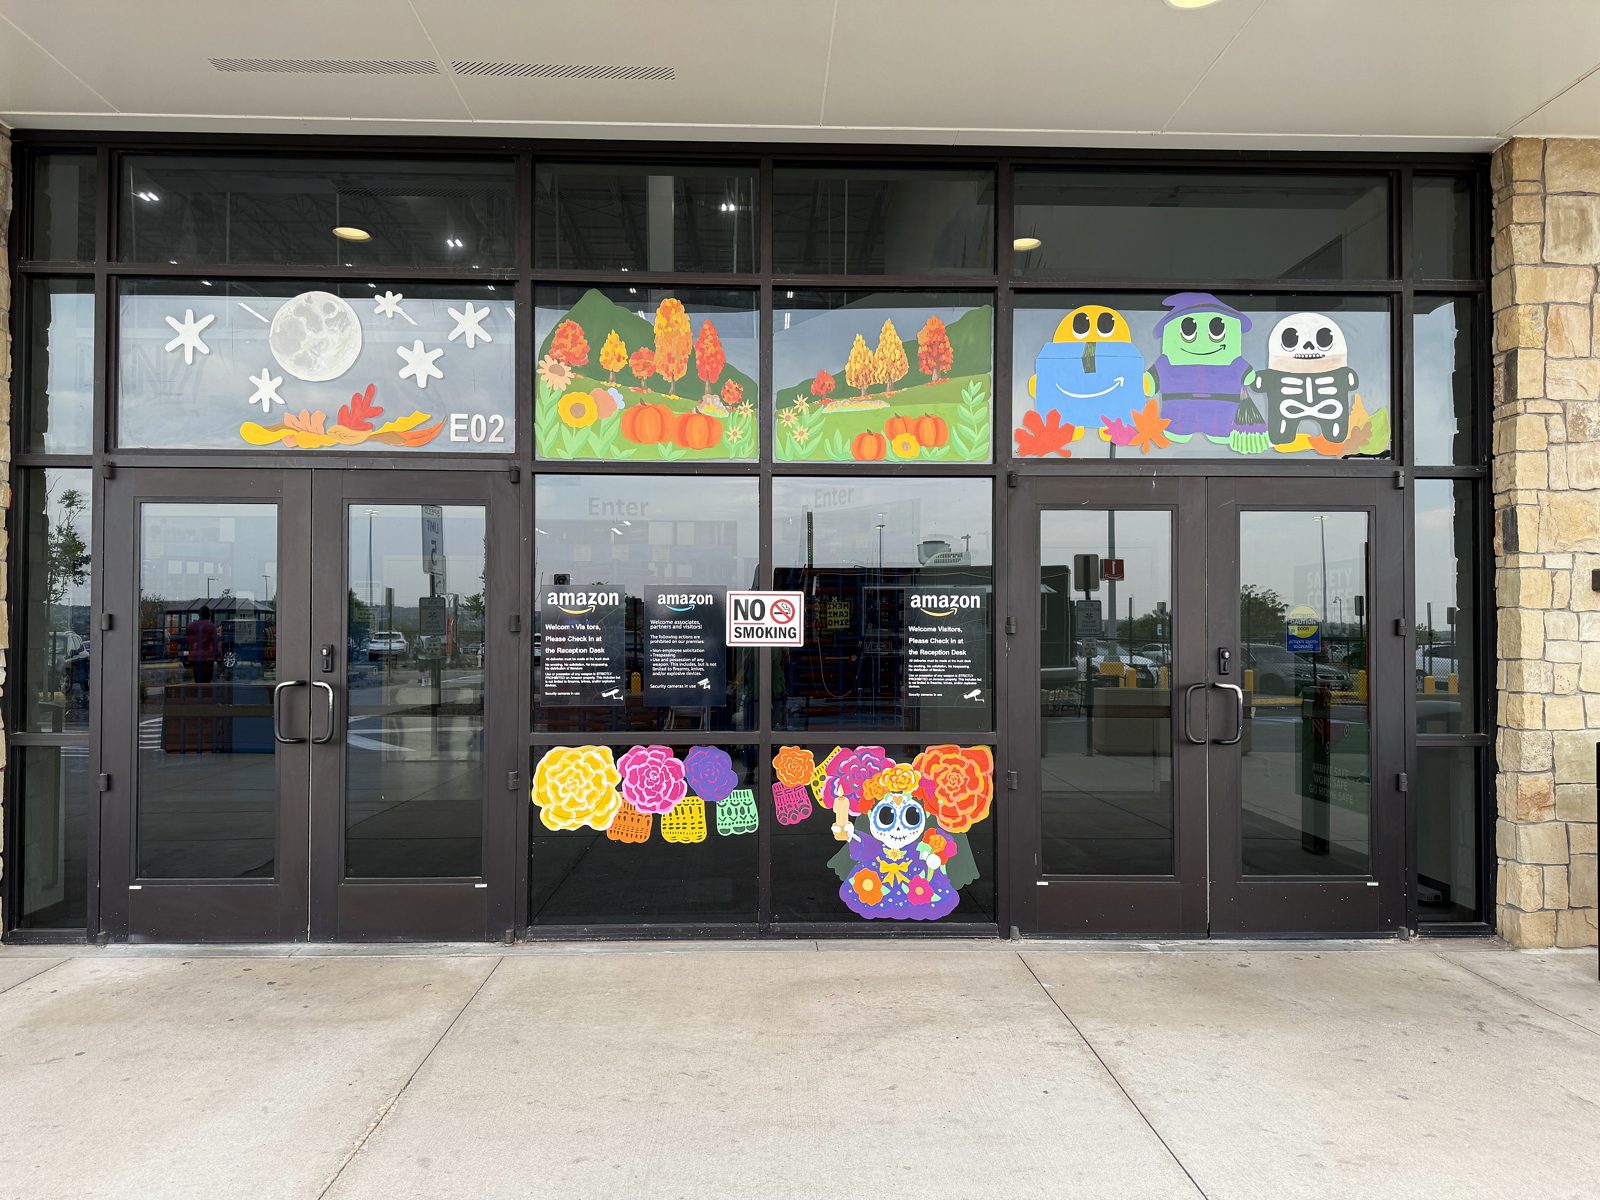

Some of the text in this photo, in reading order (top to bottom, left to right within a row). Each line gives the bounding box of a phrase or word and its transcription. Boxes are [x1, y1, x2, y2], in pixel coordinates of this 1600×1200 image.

[450, 413, 504, 442] E02
[815, 488, 854, 508] Enter
[588, 498, 648, 516] Enter
[548, 592, 618, 605] amazon
[658, 593, 713, 605] amazon
[910, 594, 980, 608] amazon
[734, 599, 766, 621] NO
[734, 627, 796, 639] SMOKING
[1309, 784, 1317, 794] GO
